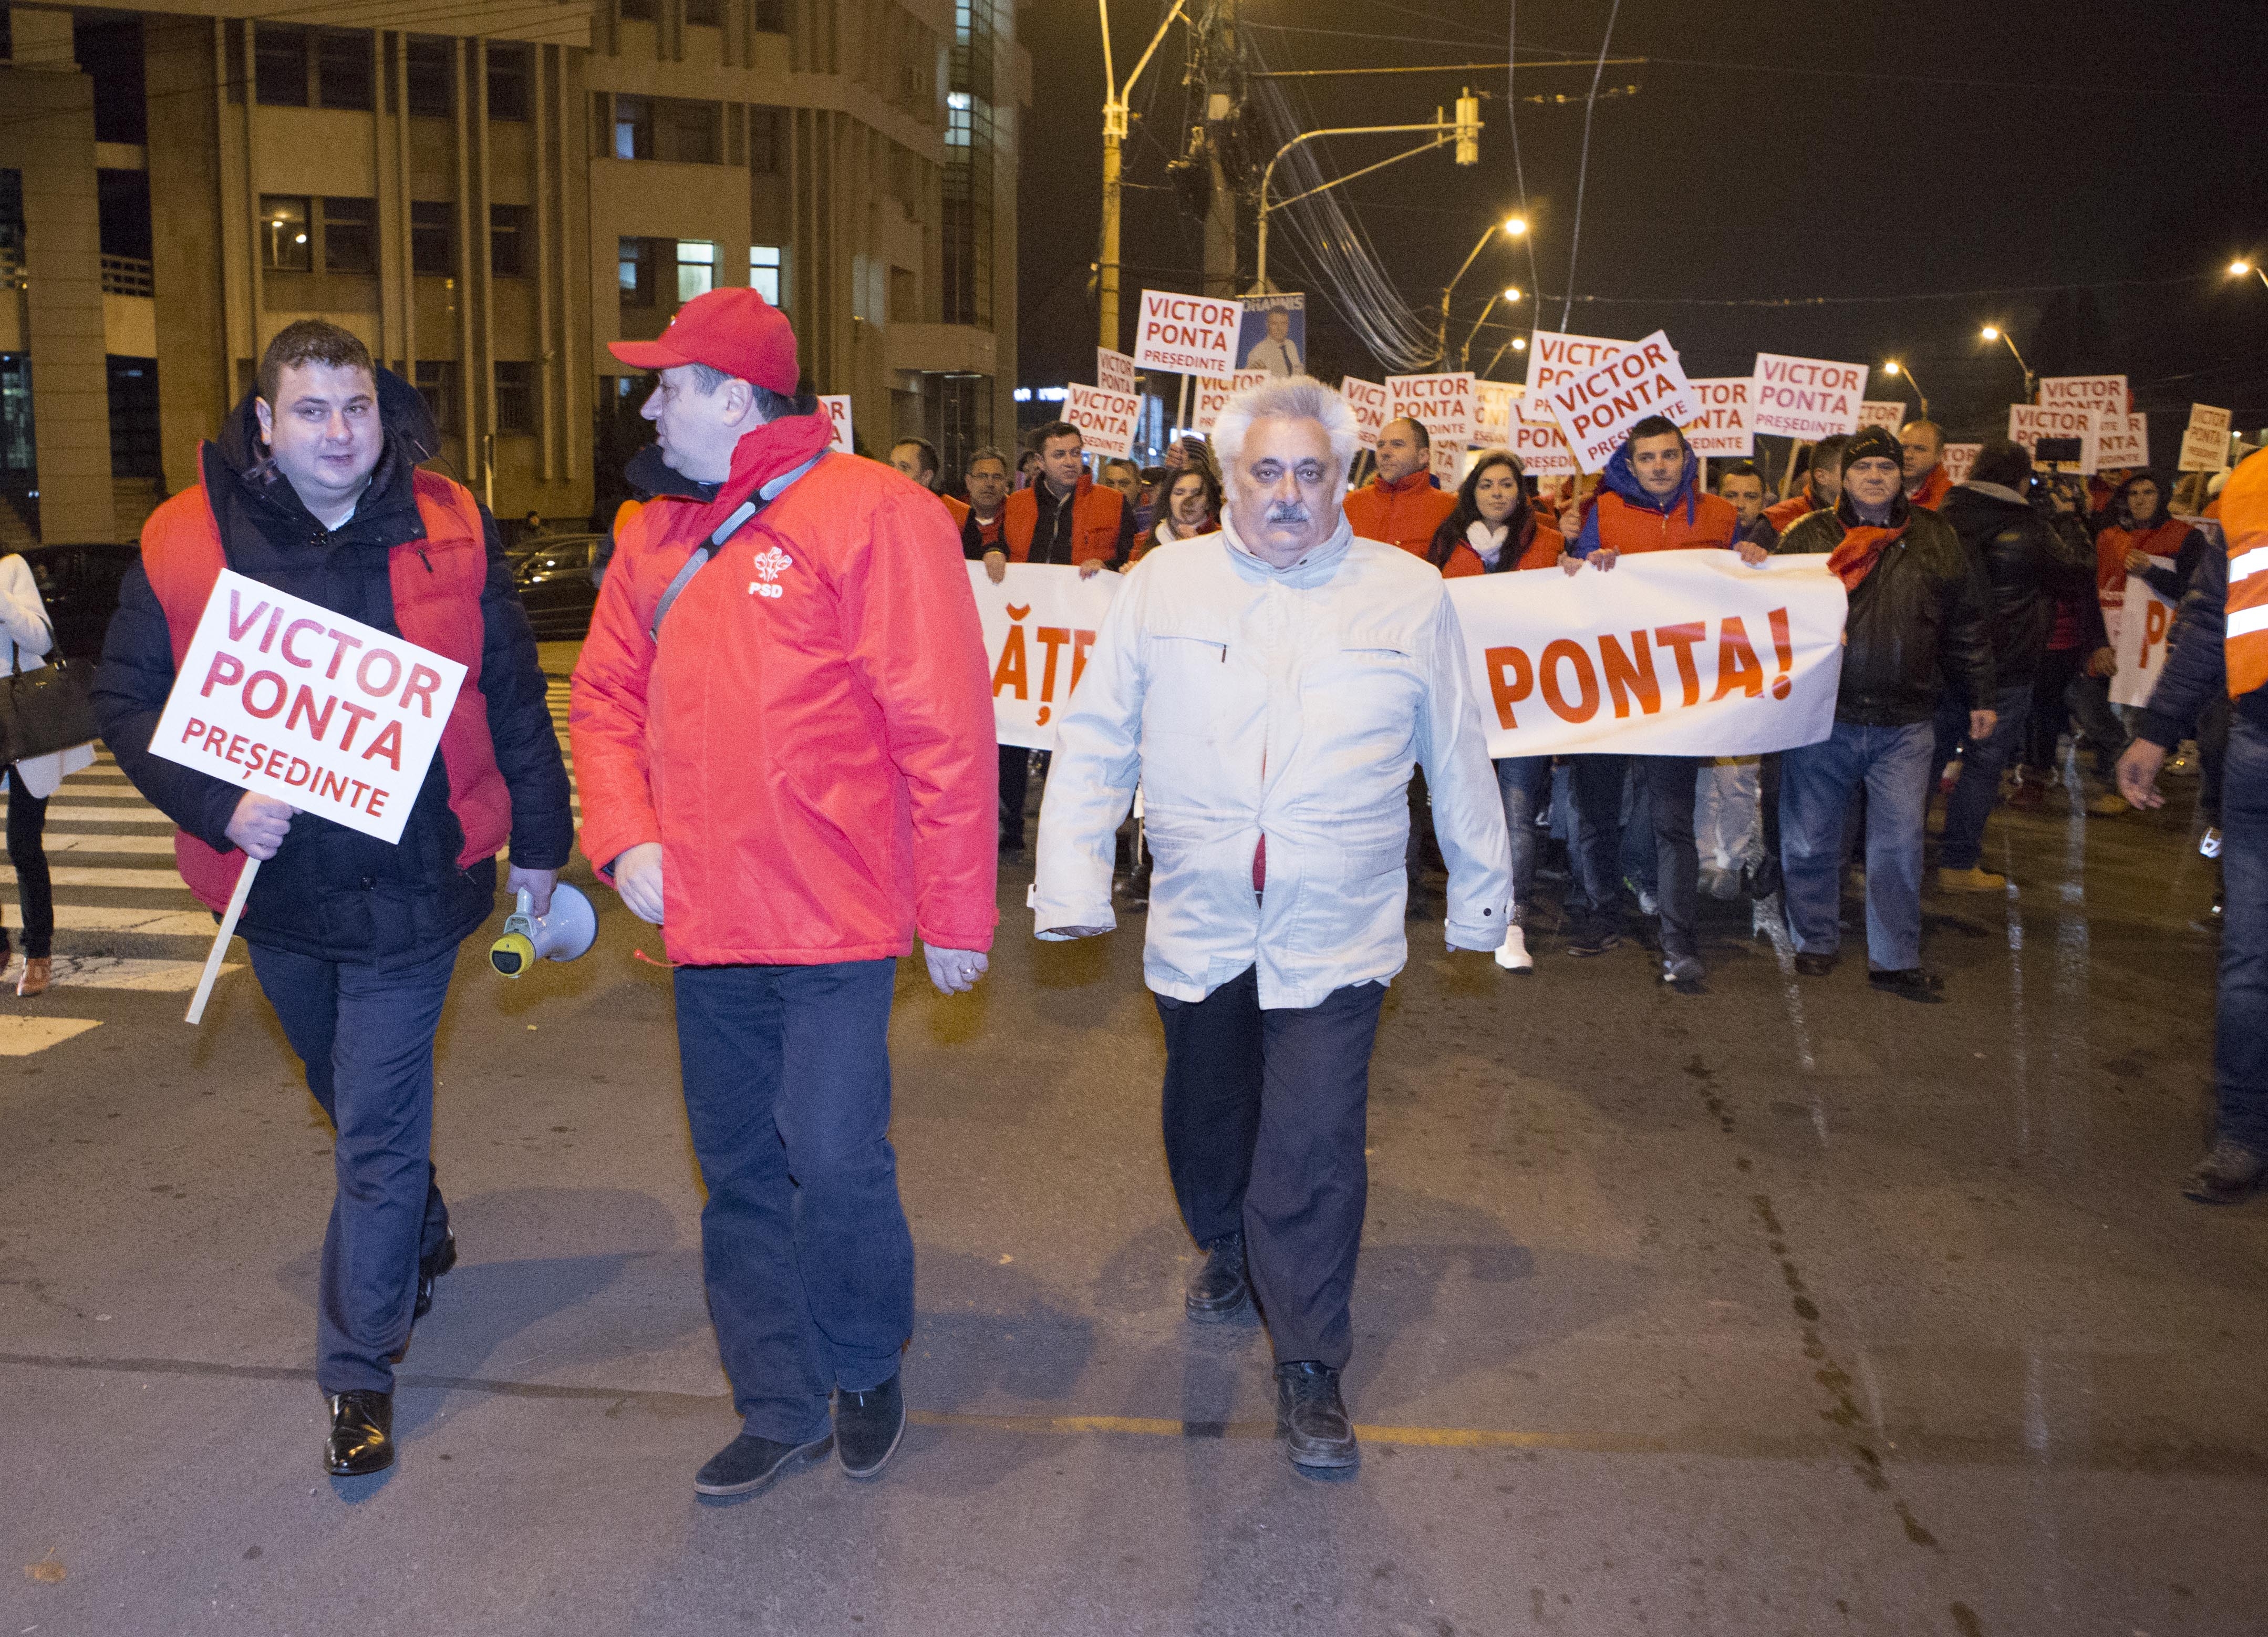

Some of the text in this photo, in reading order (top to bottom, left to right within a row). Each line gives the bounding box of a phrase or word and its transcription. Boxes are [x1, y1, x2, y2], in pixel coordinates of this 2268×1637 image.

[1148, 296, 1235, 327] VICTOR
[1146, 322, 1227, 352] PONTA
[1390, 377, 1469, 398] VICTOR
[1555, 343, 1668, 412] VICTOR
[1763, 360, 1859, 391] VICTOR
[2044, 379, 2121, 398] VICTOR
[1072, 388, 1137, 417] VICTOR
[1393, 399, 1466, 419] PONTA
[1572, 373, 1676, 439] PONTA
[1690, 384, 1747, 404] TOR
[1759, 385, 1849, 416] PONTA
[1068, 408, 1128, 436] PONTA
[1679, 409, 1743, 429] NTA
[2016, 409, 2089, 431] VICTOR
[748, 581, 783, 599] PSD
[228, 589, 442, 718] VICTOR
[1485, 606, 1793, 730] PONTA!
[201, 651, 403, 771] PONTA
[181, 717, 390, 817] PREȘEDINTE
